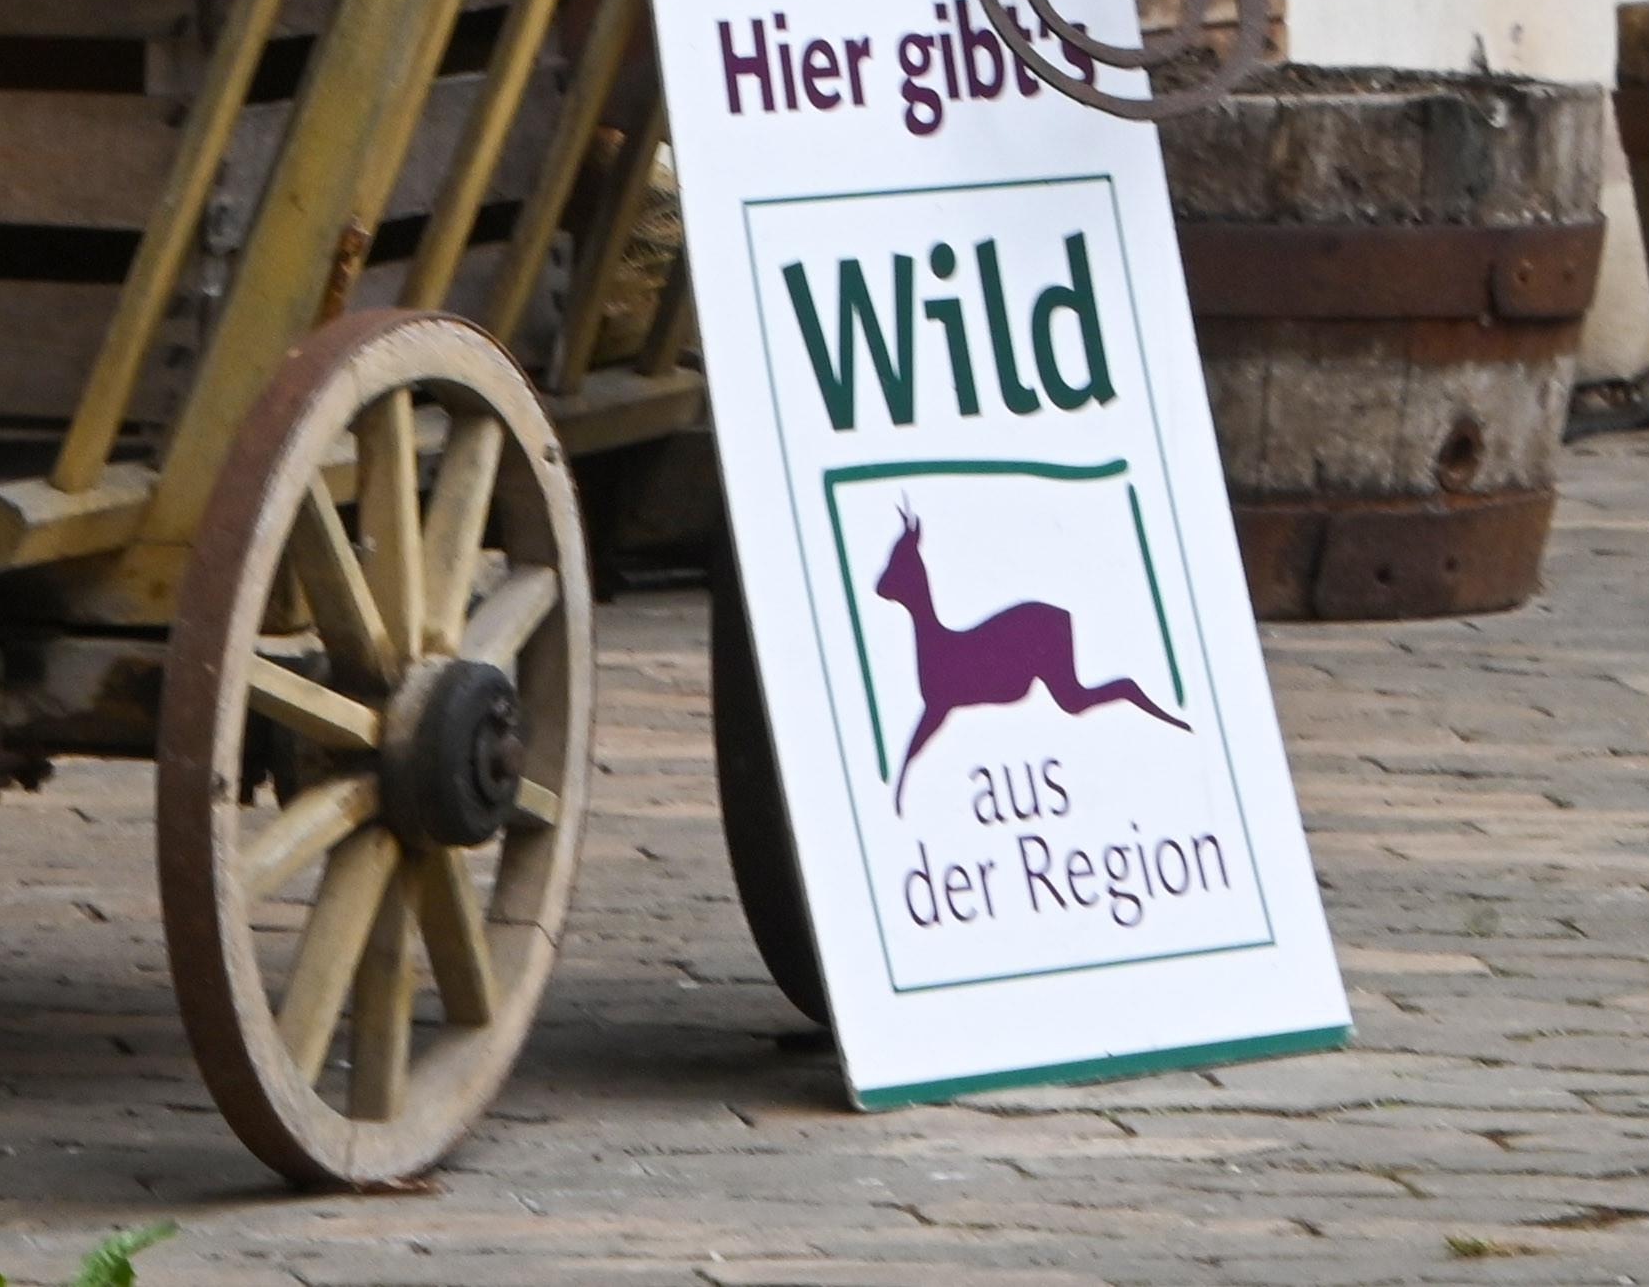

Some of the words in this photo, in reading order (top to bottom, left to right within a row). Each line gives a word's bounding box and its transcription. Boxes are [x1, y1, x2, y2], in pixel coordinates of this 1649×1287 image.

[717, 11, 871, 115] Hier
[782, 228, 1118, 431] Wild
[968, 757, 1070, 826] aus
[904, 840, 999, 928] der
[1016, 821, 1232, 928] Region
